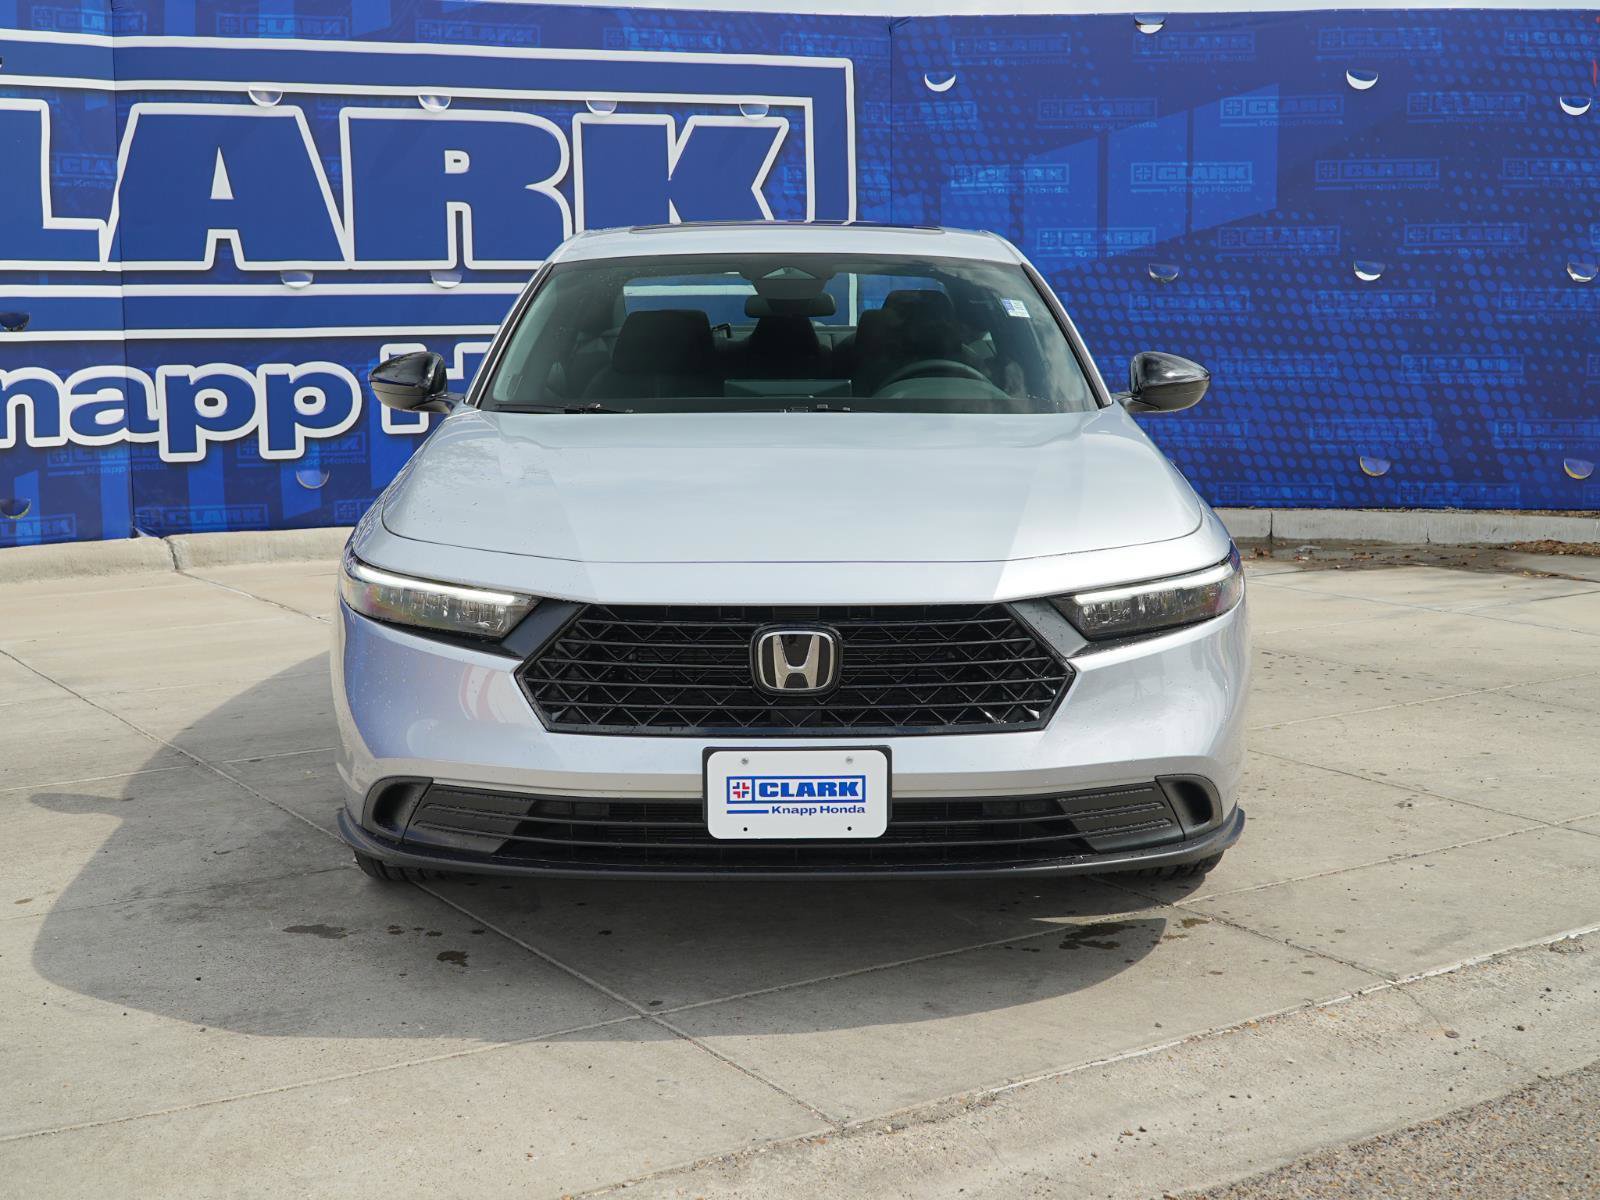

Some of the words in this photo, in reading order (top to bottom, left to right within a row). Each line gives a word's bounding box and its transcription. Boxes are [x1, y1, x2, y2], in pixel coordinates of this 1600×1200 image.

[1157, 166, 1248, 180] CLARK
[758, 781, 859, 798] CLARK
[771, 805, 817, 817] Knapp
[819, 805, 866, 815] Honda
